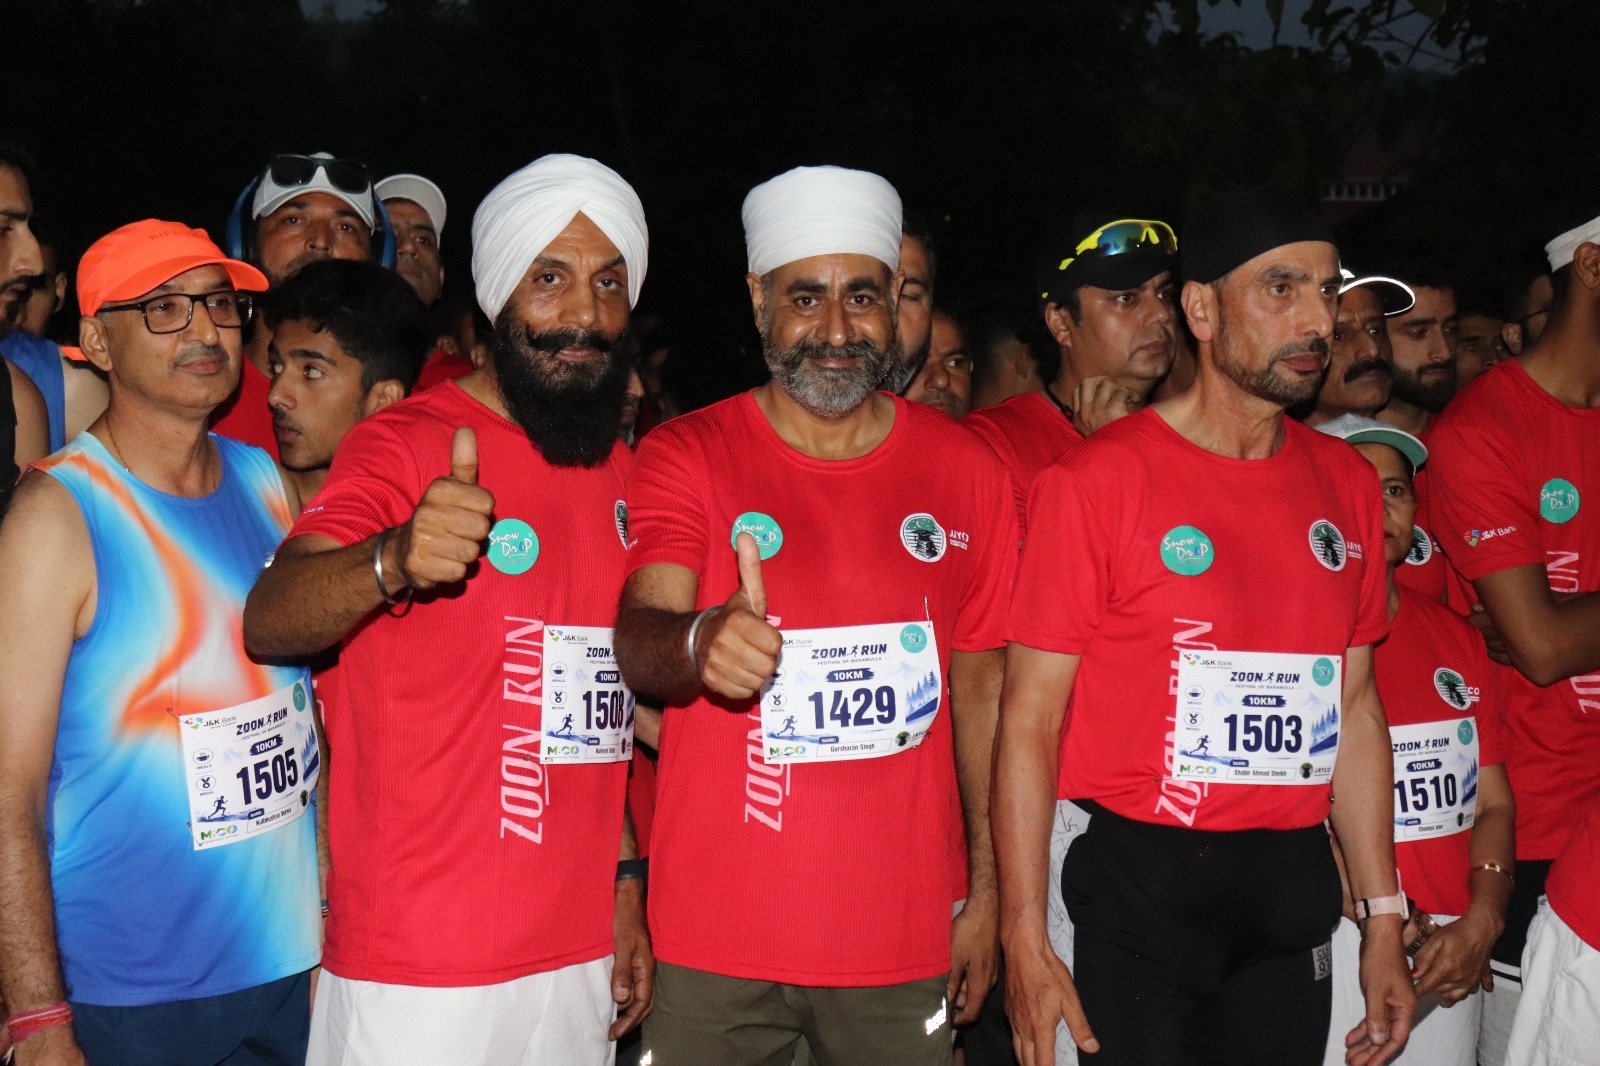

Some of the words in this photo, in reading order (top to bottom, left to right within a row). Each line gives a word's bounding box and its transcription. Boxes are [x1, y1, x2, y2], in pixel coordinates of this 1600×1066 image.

[1541, 489, 1564, 500] Snow
[736, 519, 764, 532] Snow
[488, 531, 519, 545] Snow
[1164, 537, 1195, 550] Snow
[586, 647, 611, 658] ZOON
[811, 647, 847, 660] ZOON
[861, 643, 887, 655] RUN
[503, 616, 544, 705] RUN
[600, 673, 617, 681] 10KM
[834, 670, 863, 681] 10KM
[1230, 672, 1263, 682] ZOON
[1276, 673, 1300, 683] RUN
[808, 685, 896, 729] 1429
[1249, 696, 1277, 706] 10KM
[583, 690, 624, 730] 1508
[203, 719, 221, 727] J&K
[221, 715, 237, 723] Bank
[236, 718, 264, 736] ZOON
[273, 706, 288, 721] RUN
[241, 732, 261, 741] FESTIVAL
[1224, 714, 1303, 753] 1503
[255, 738, 278, 753] 10KM
[830, 745, 859, 753] Gursharan
[860, 743, 875, 751] Singh
[1393, 741, 1421, 752] ZOON
[1432, 737, 1450, 748] RUN
[1412, 761, 1435, 770] 10KM
[236, 747, 299, 805] 1505
[500, 724, 543, 844] ZOON
[1394, 773, 1457, 813] 1510
